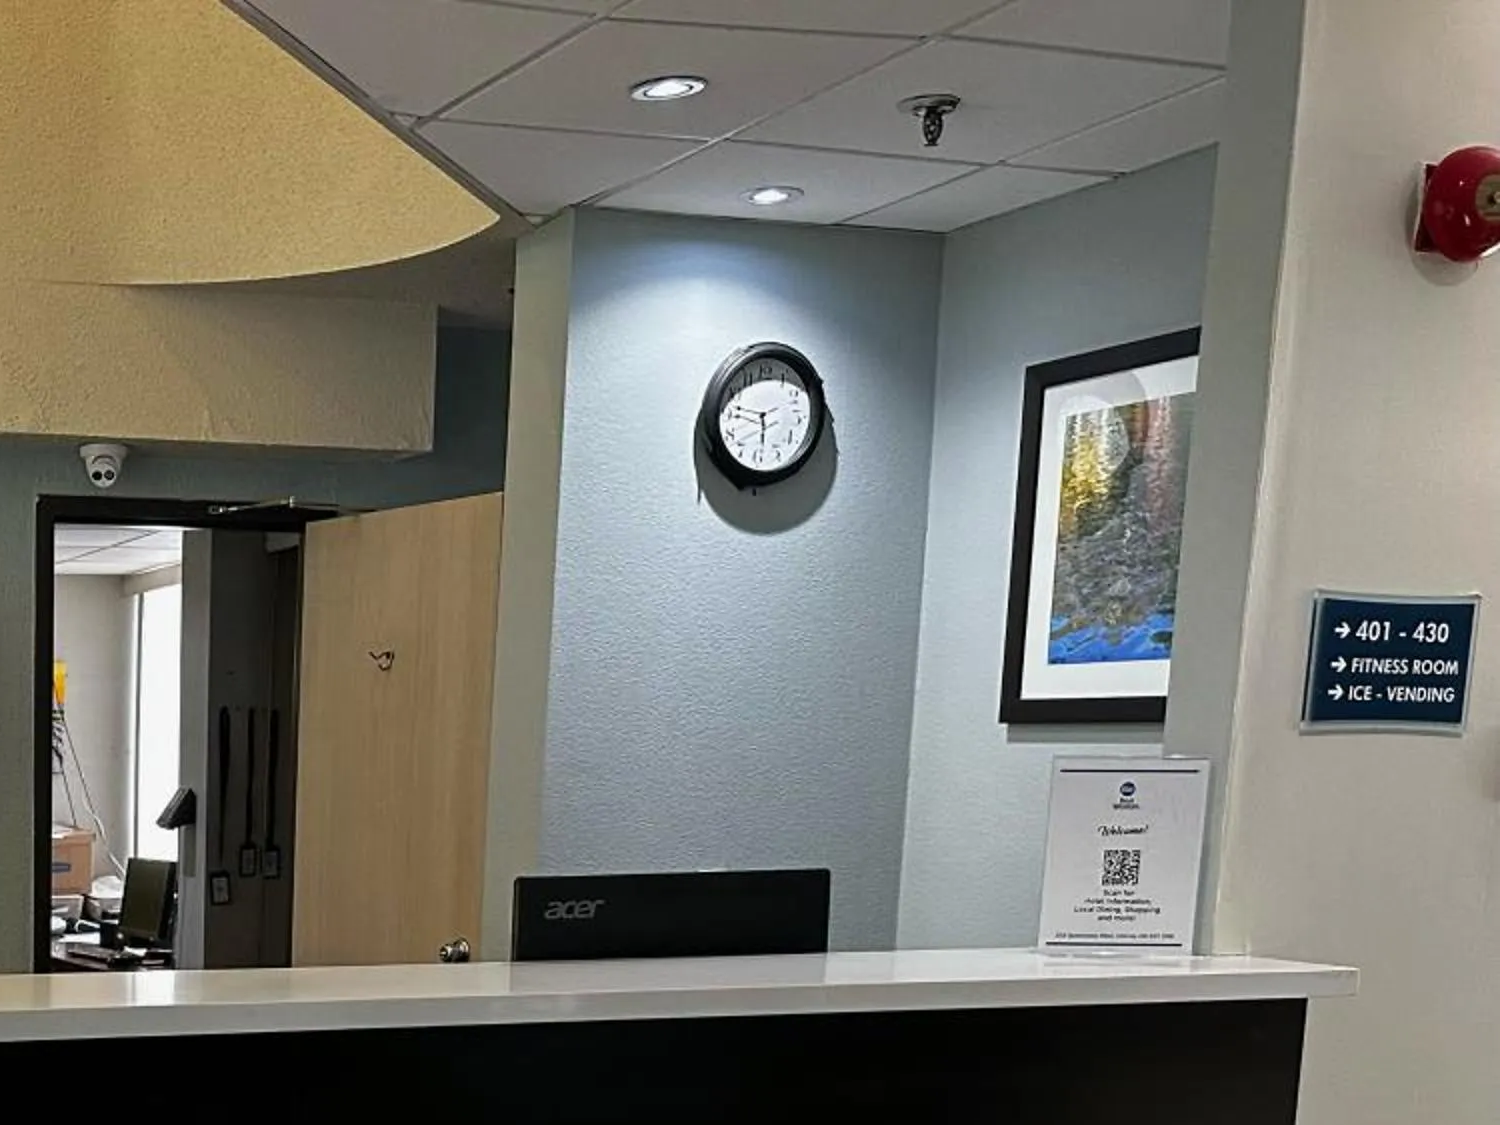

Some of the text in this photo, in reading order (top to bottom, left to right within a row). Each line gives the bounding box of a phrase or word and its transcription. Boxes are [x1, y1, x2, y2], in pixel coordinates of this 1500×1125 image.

[1355, 620, 1391, 641] 401
[1412, 622, 1450, 643] 430
[1351, 657, 1459, 675] FITNESS ROOM
[1348, 685, 1373, 701] ICE
[1387, 686, 1455, 703] VENDING
[544, 899, 606, 919] acer
